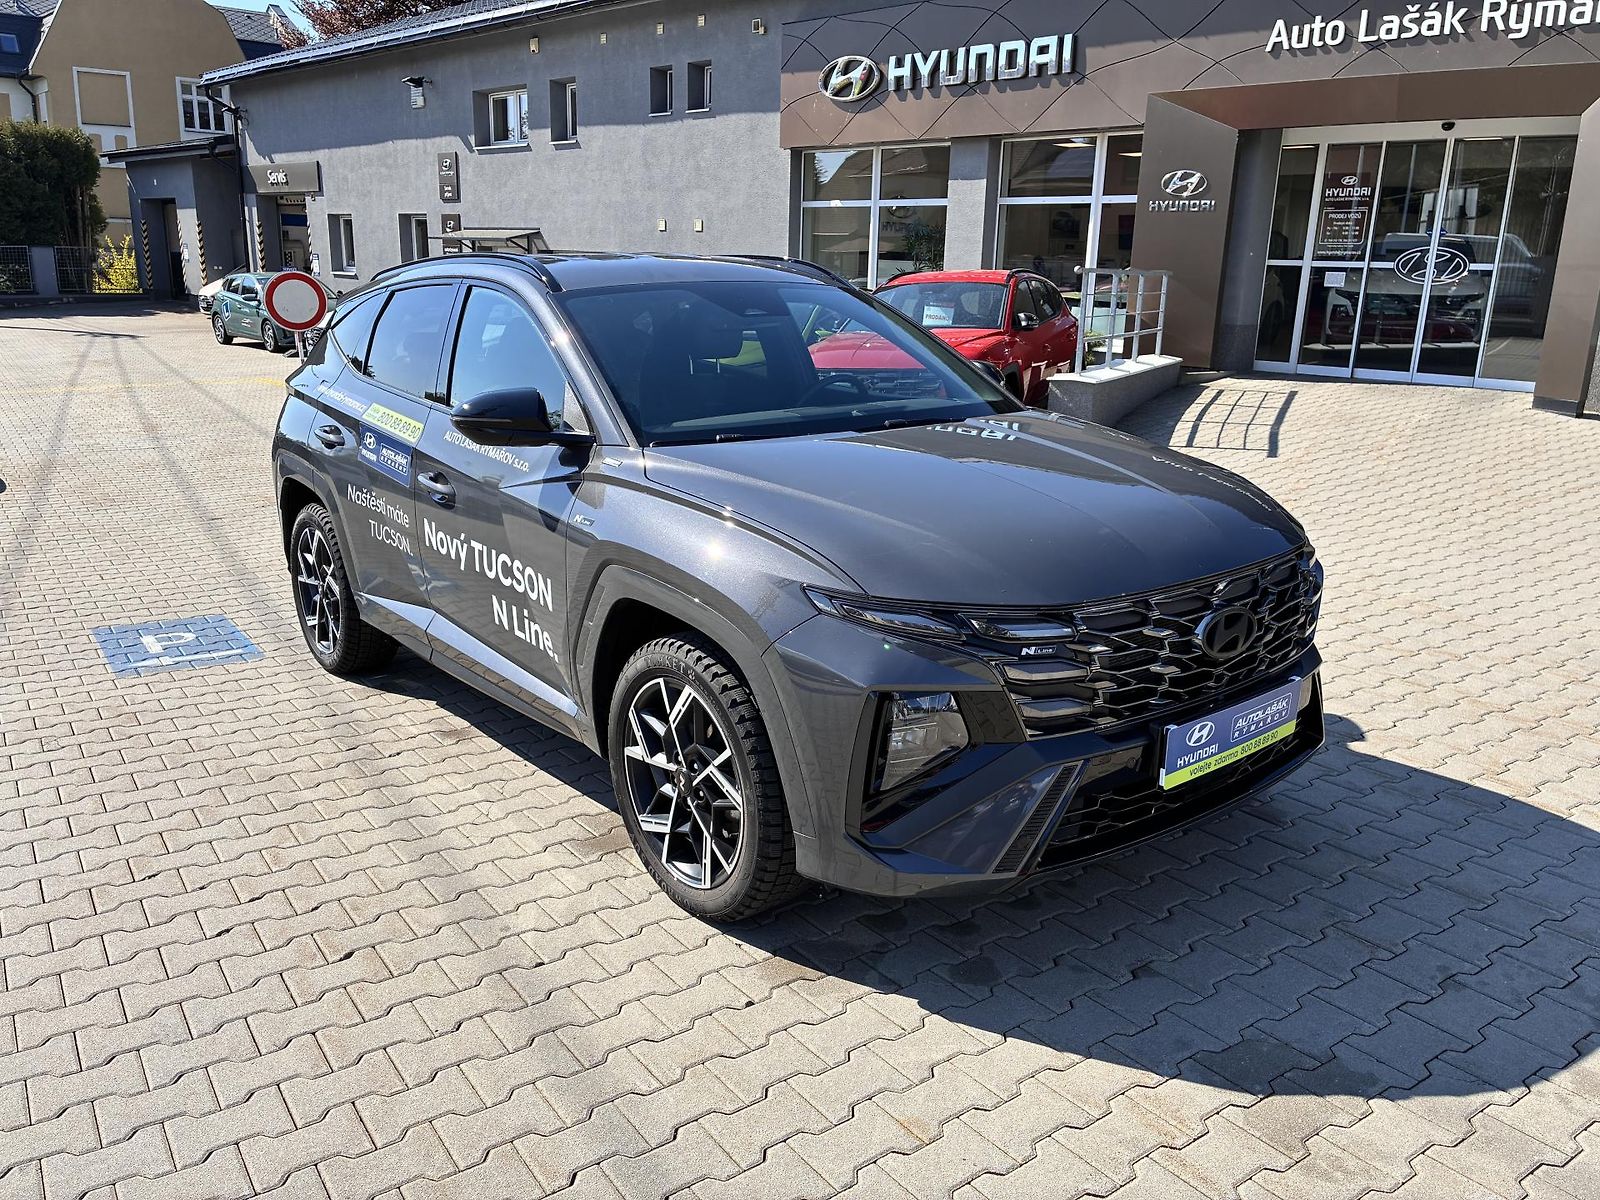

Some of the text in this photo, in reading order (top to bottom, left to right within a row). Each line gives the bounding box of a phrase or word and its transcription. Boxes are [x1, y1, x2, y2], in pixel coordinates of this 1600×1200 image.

[1265, 15, 1346, 52] Auto
[1357, 1, 1468, 43] Lašák
[887, 33, 1074, 92] HYUNDAI
[267, 168, 287, 184] Servis
[1325, 187, 1371, 197] HYUNDAI
[1148, 200, 1216, 212] HYUNDAI
[408, 425, 421, 439] 90
[443, 430, 461, 446] AUTO
[513, 457, 530, 472] s.r.o.
[347, 483, 410, 529] Naštěstí máte
[368, 519, 414, 557] TUCSON.
[423, 518, 553, 612] Nový TUCSON
[491, 595, 560, 664] N Line.
[1021, 646, 1036, 656] N
[1234, 697, 1288, 729] AUTOLAŠÁK
[1177, 743, 1219, 768] HYUNDAI
[1189, 730, 1279, 777] volejte zdarma 800 88 89 90
